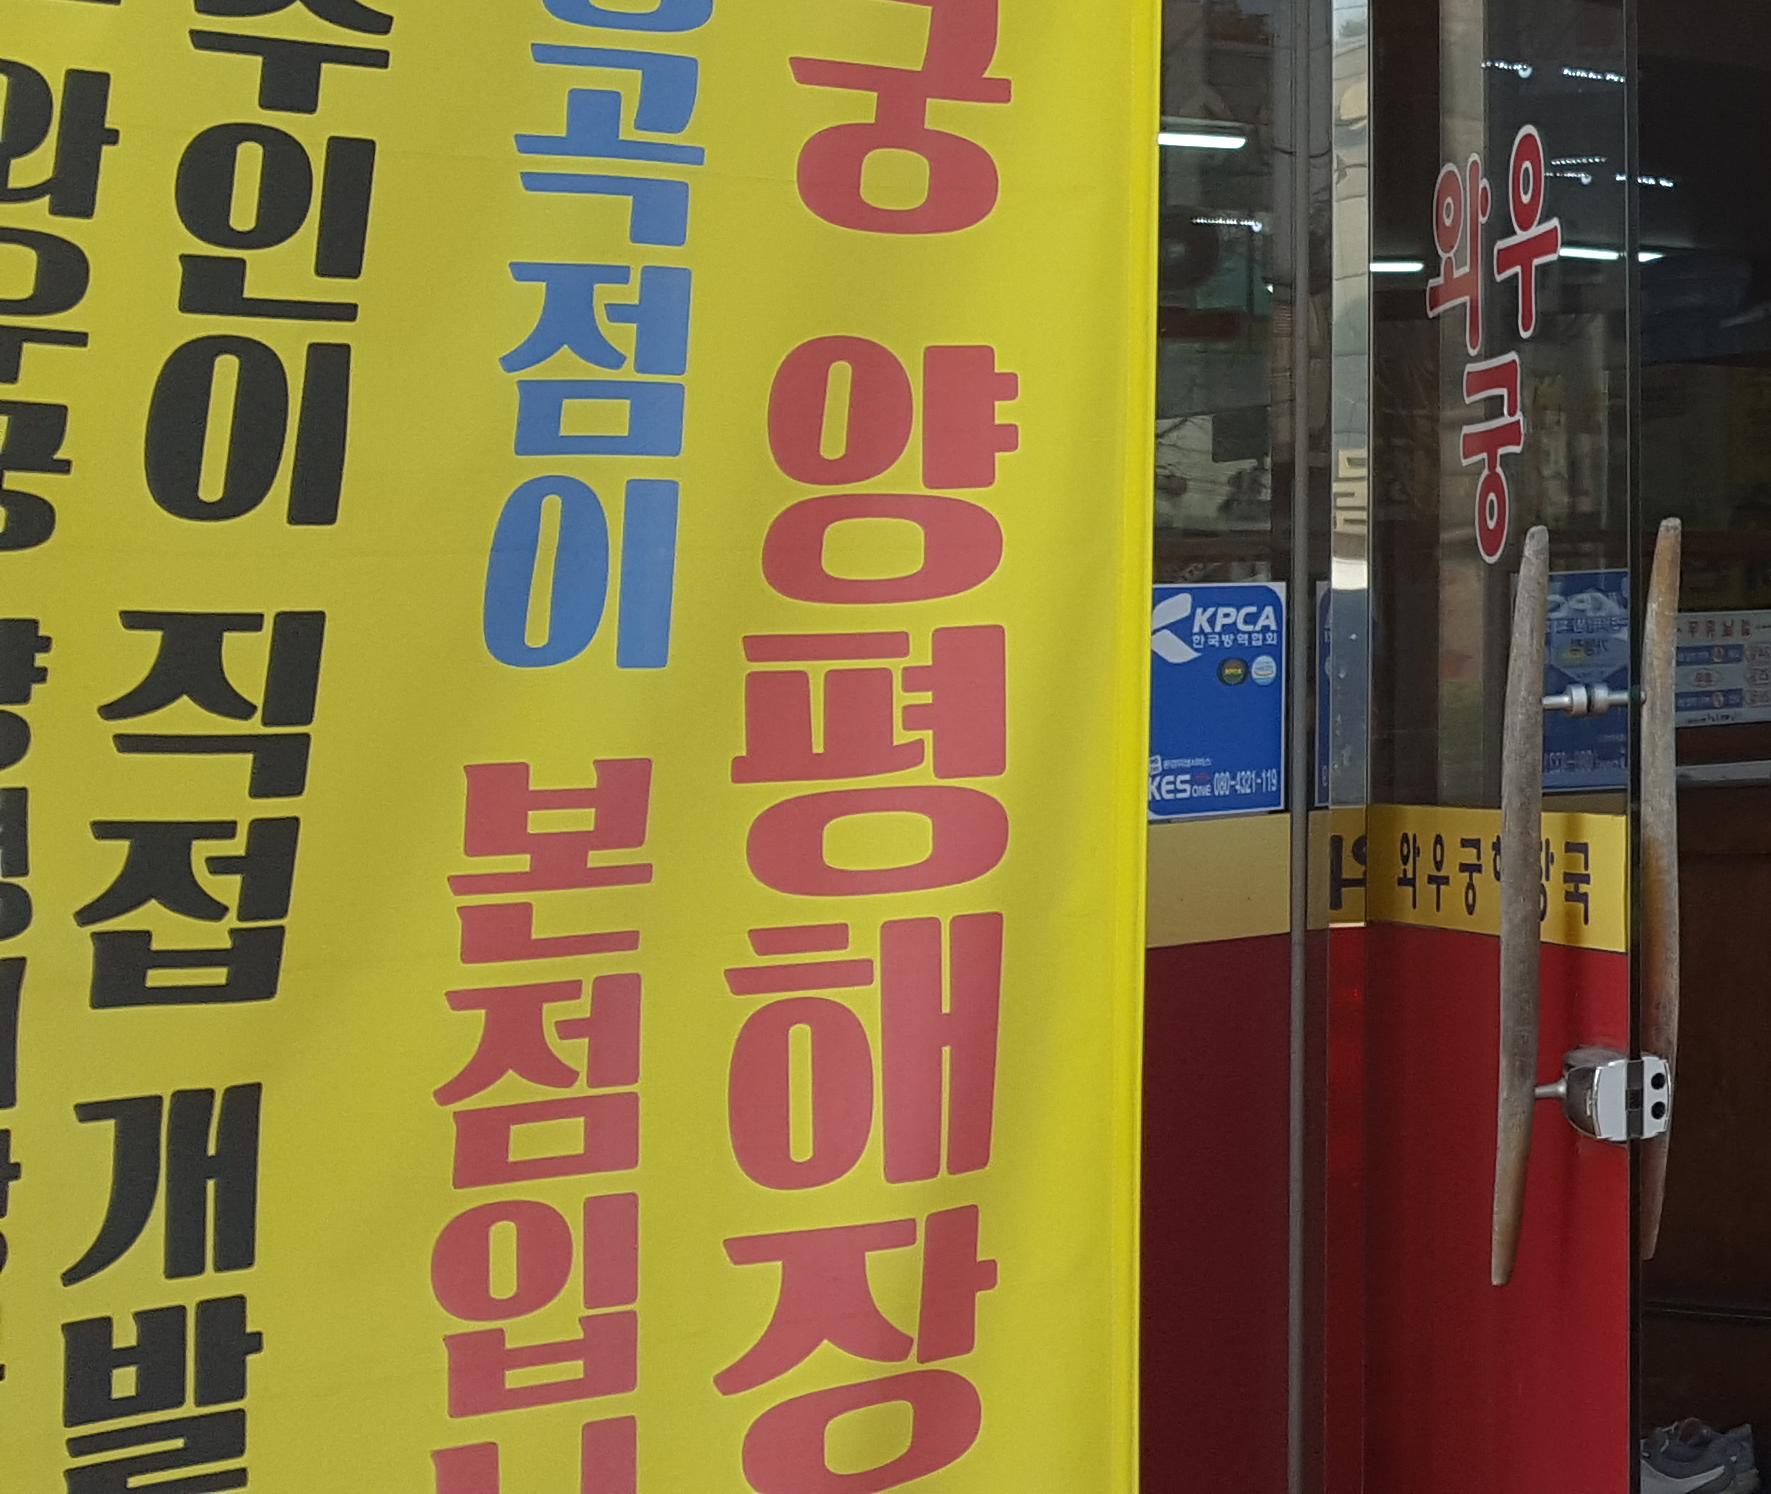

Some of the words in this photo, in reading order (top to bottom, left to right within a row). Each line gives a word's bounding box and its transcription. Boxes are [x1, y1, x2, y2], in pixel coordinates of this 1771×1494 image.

[1426, 123, 1562, 565] 와우궁
[72, 609, 327, 1011] 직접
[1191, 605, 1279, 633] KPCA
[712, 334, 1020, 1494] 양평해장
[60, 1082, 265, 1494] 개발
